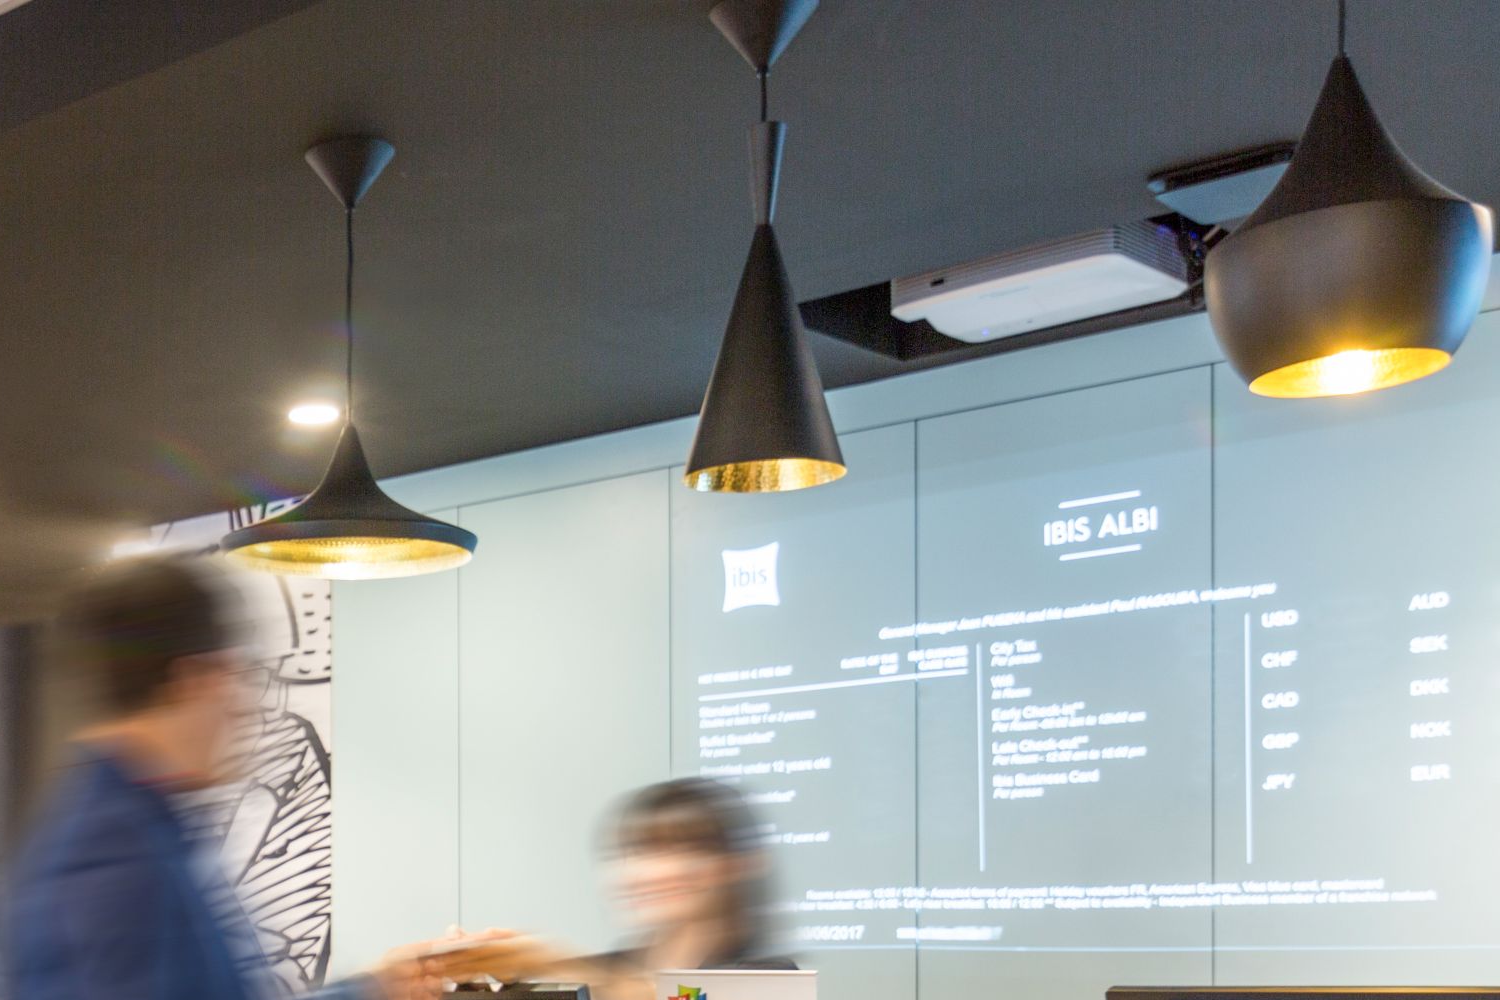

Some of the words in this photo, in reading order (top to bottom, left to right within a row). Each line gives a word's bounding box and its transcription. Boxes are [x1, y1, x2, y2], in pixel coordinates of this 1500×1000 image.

[1044, 516, 1091, 546] IBIS
[1098, 506, 1158, 538] ALBI
[732, 566, 768, 588] ibis
[1408, 591, 1450, 611] AUD
[1261, 609, 1299, 628] USD
[990, 641, 1014, 656] City
[1409, 634, 1449, 653] SEK
[1261, 650, 1298, 668] CHF
[1409, 677, 1450, 696] DKK
[1261, 691, 1299, 709] CAD
[1409, 720, 1451, 739] NOK
[992, 741, 1018, 755] Late
[1262, 732, 1299, 750] GBP
[1068, 769, 1100, 783] Card
[1410, 763, 1451, 781] EUR
[1262, 773, 1296, 790] JPY
